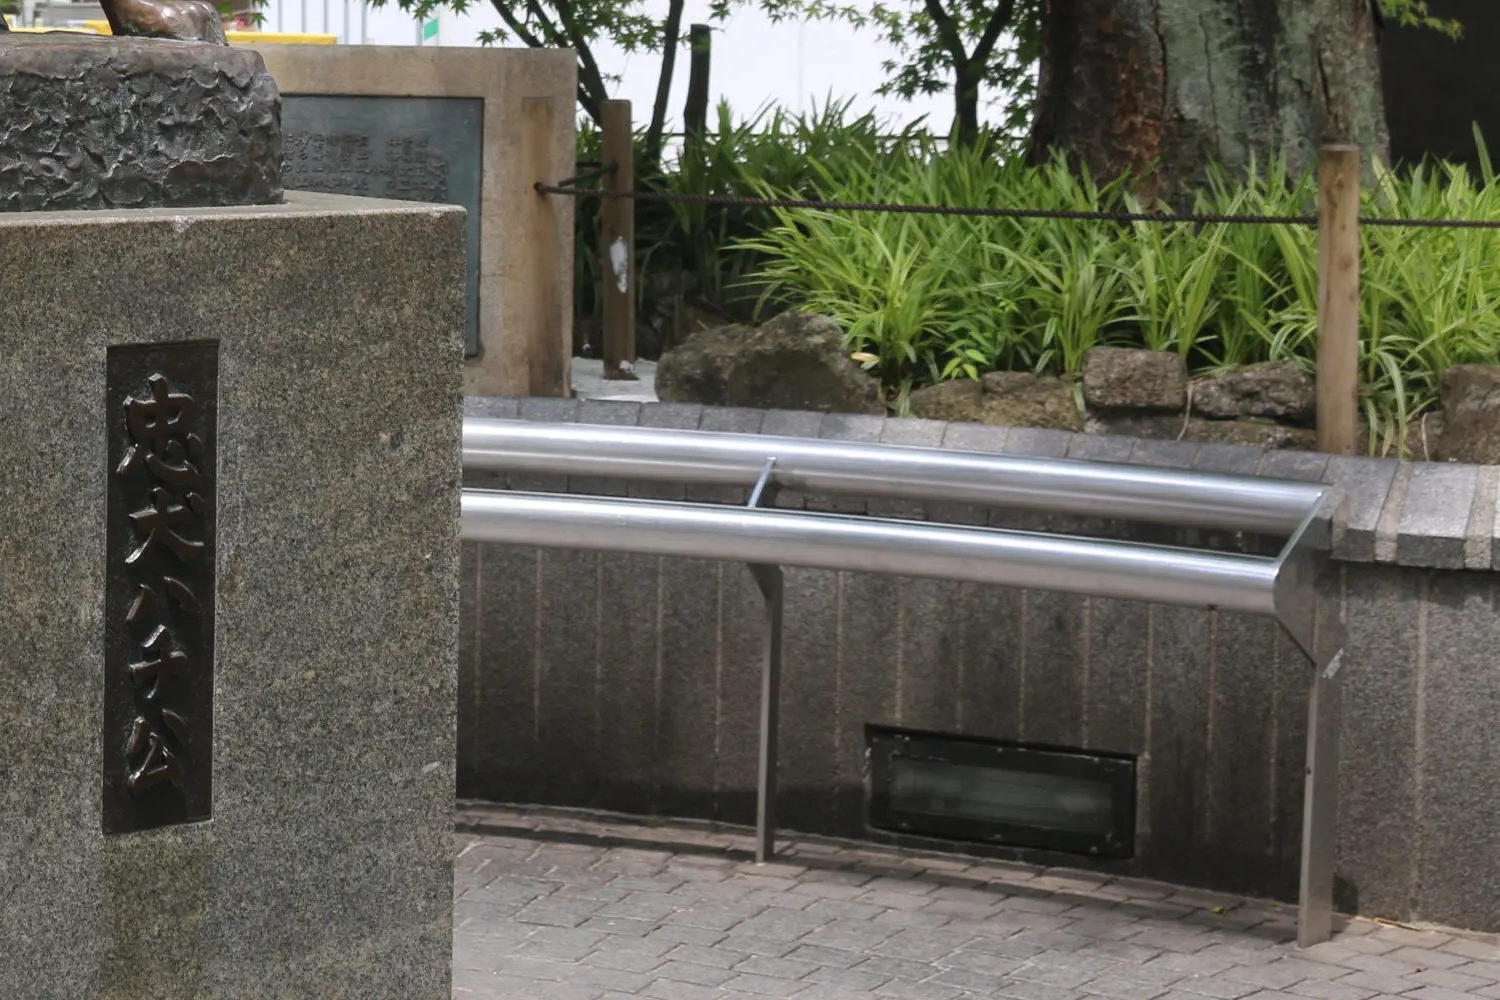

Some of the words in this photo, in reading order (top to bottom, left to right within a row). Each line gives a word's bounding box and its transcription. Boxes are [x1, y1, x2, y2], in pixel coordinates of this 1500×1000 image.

[117, 372, 204, 790] 忠犬ハチ公
